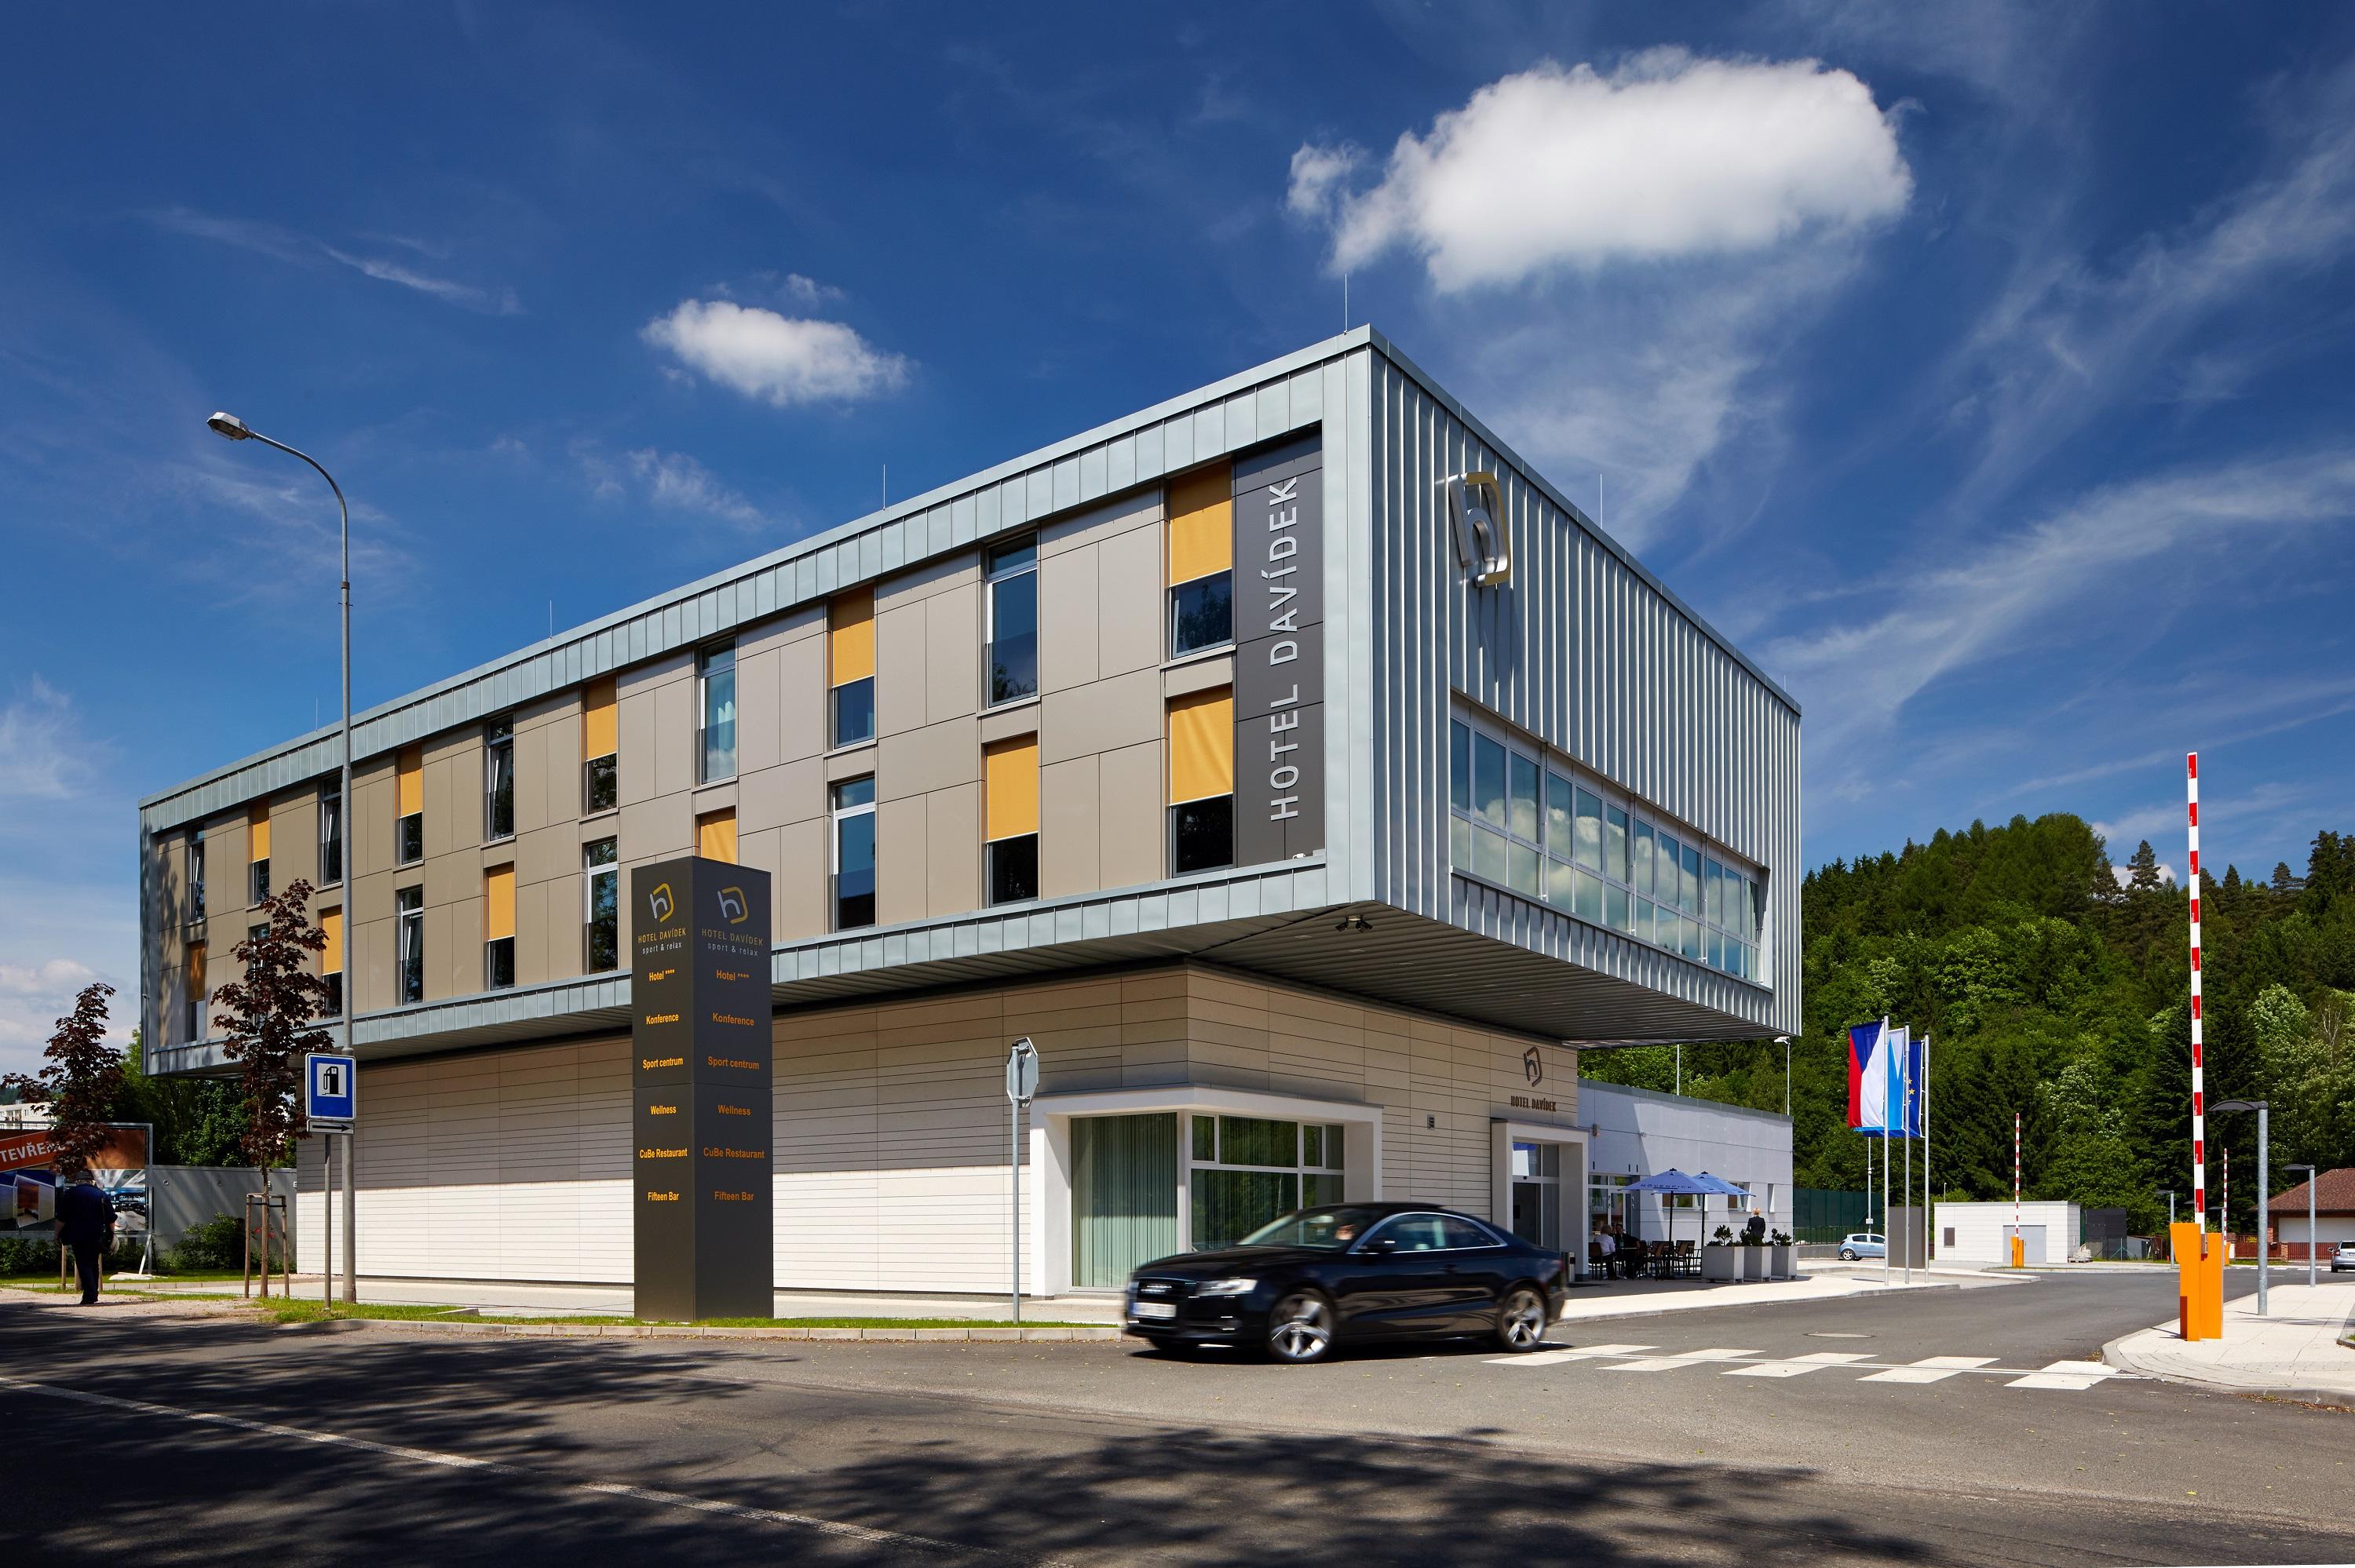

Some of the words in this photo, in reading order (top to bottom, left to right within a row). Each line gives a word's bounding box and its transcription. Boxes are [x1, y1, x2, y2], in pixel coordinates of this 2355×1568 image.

[1261, 476, 1298, 667] DAVÍDEK
[1269, 684, 1299, 822] HOTEL
[637, 932, 657, 943] HOTEL
[659, 927, 687, 940] DAVÍDEK
[701, 928, 727, 940] HOTEL
[730, 932, 764, 946] DAVÍDEK
[642, 944, 659, 954] sport
[666, 942, 682, 950] relax
[707, 943, 728, 953] sport
[739, 947, 758, 957] relax
[648, 970, 664, 982] Hotel
[716, 969, 736, 981] Hotel
[646, 1012, 679, 1025] Konference
[712, 1012, 754, 1026] Konference
[642, 1059, 659, 1071] Sport
[659, 1057, 684, 1068] centrum
[707, 1056, 728, 1069] Sport
[730, 1059, 759, 1070] centrum
[650, 1105, 677, 1115] Wellness
[717, 1104, 751, 1116] Wellness
[1510, 1096, 1529, 1108] HOTEL
[1532, 1098, 1557, 1112] DAVÍDEK
[639, 1149, 655, 1158] CuBe
[655, 1147, 688, 1158] Restaurant
[703, 1147, 724, 1158] CuBe
[725, 1148, 765, 1159] Restaurant
[648, 1191, 667, 1202] Fifteen
[668, 1192, 679, 1202] Bar
[714, 1191, 740, 1201] Fifteen
[741, 1191, 754, 1202] Bar
